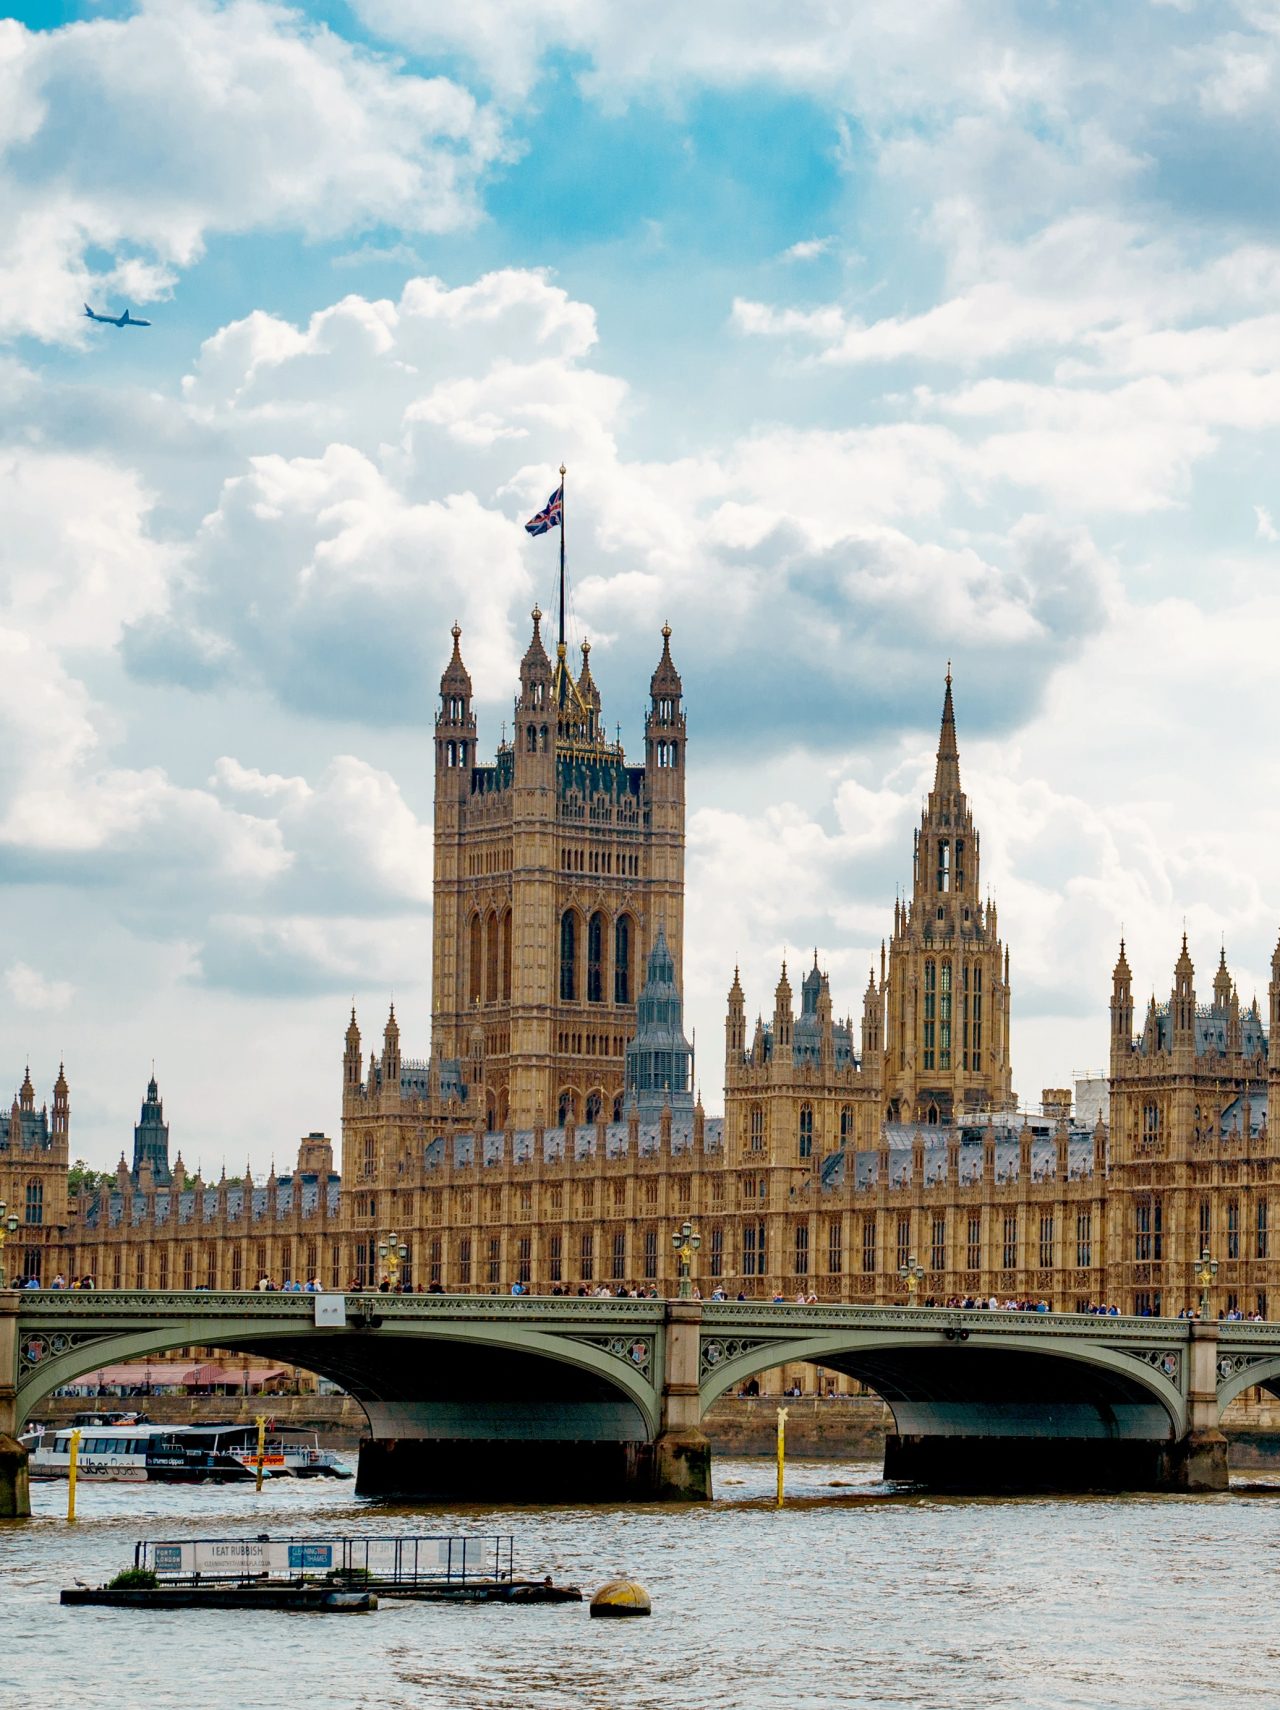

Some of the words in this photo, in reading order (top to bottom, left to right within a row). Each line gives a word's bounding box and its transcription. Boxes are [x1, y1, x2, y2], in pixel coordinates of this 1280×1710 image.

[80, 1457, 109, 1475] Uber
[110, 1457, 138, 1476] Boat
[216, 1546, 229, 1556] EAT
[231, 1545, 263, 1556] RUBBISH
